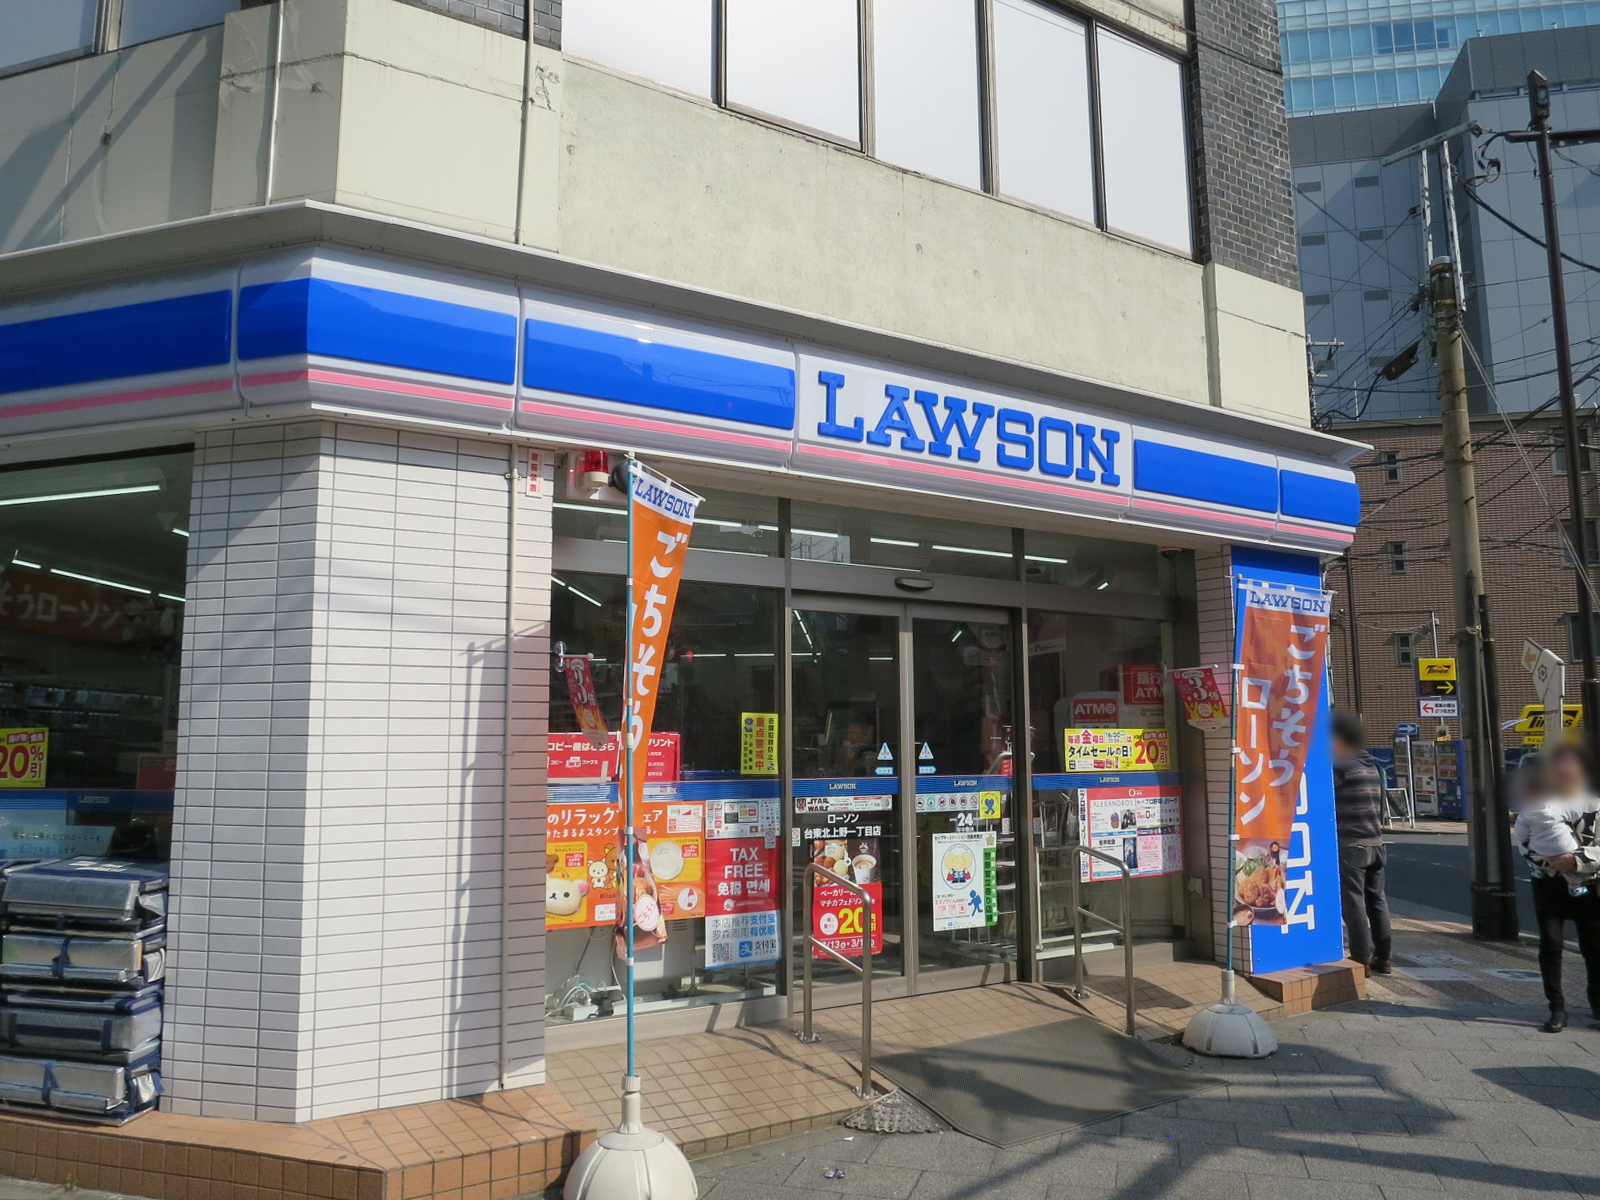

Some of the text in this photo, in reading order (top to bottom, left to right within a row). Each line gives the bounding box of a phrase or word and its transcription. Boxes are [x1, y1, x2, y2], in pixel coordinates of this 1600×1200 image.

[818, 369, 1121, 487] LAWSON
[634, 477, 692, 519] LAWSON
[1249, 590, 1326, 613] LAWSON
[627, 531, 688, 752] ごちそう
[1426, 664, 1451, 675] Times
[1268, 622, 1326, 787] ごちそう
[1068, 745, 1133, 758] タイムセールの日!
[1238, 676, 1272, 826] ローソン
[807, 797, 829, 805] STAR
[547, 807, 620, 826] のリラック
[827, 813, 859, 824] ローソン
[957, 812, 974, 827] 24
[803, 825, 882, 840] 台東北上野一丁目店
[730, 846, 759, 862] TAX
[724, 863, 763, 880] FREE
[717, 881, 743, 897] 免税
